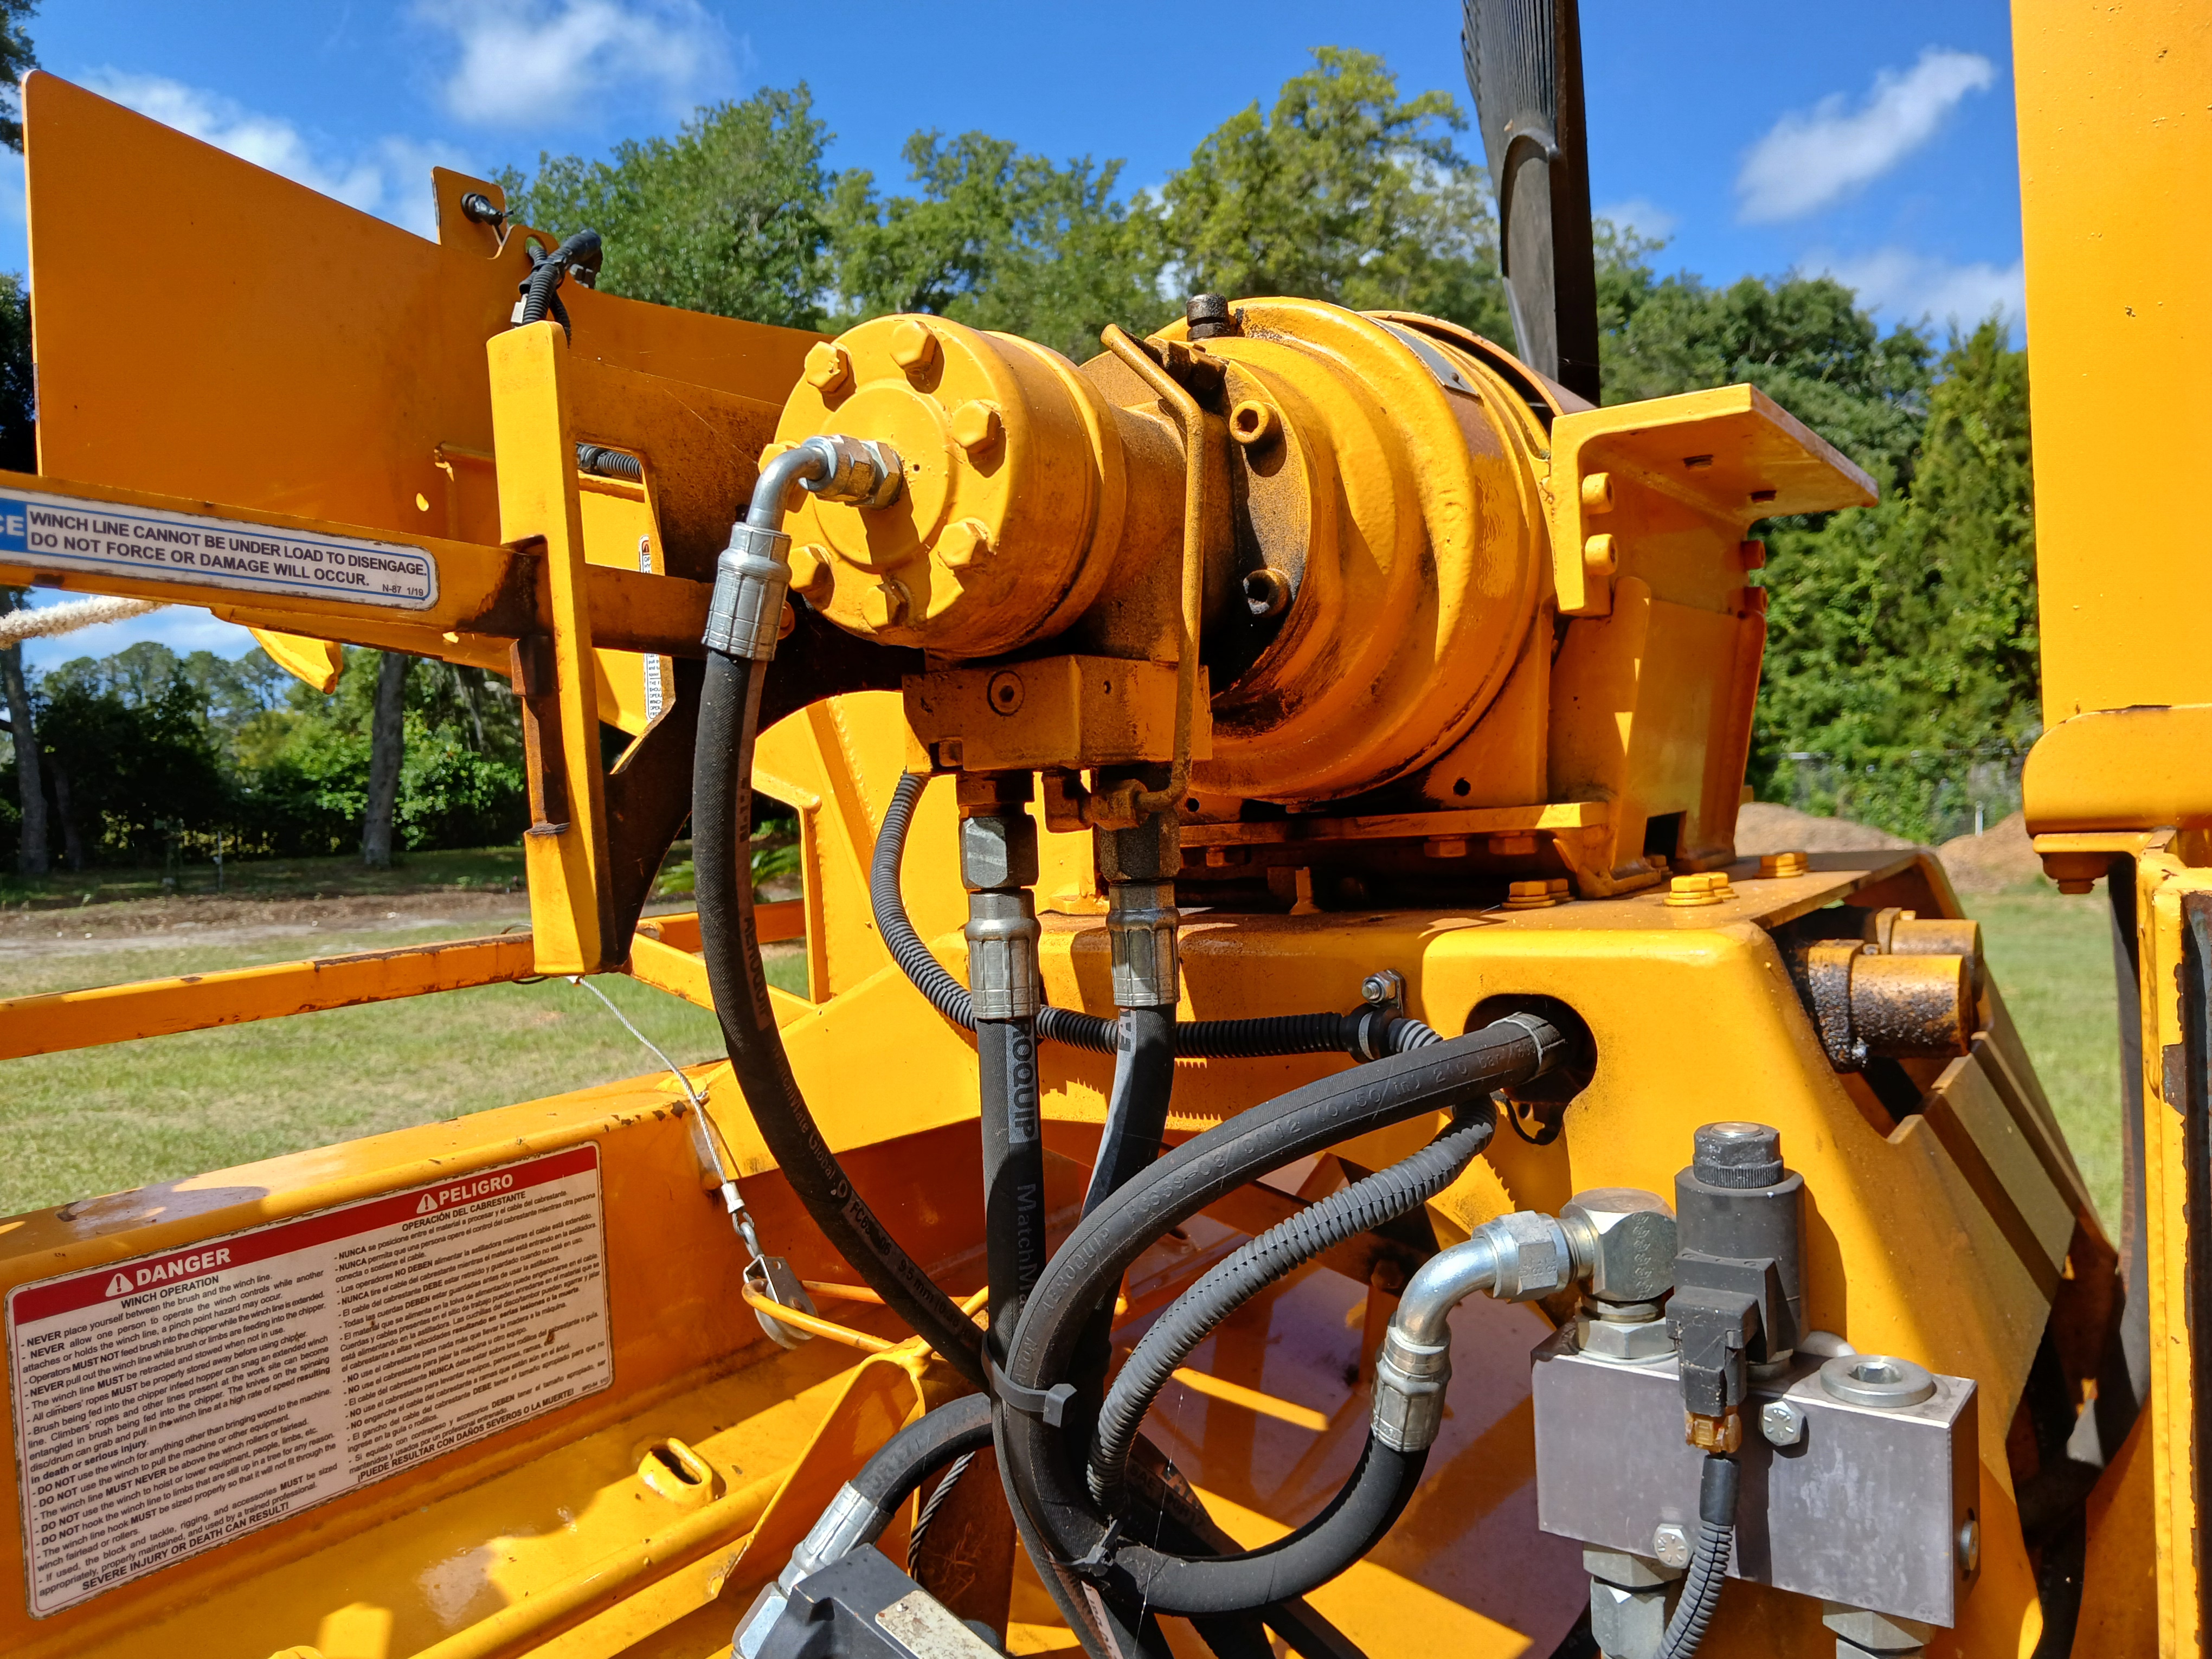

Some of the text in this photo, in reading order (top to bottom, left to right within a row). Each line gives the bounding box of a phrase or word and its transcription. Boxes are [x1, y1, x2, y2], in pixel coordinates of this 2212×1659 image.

[30, 511, 427, 576] WINCH LINE CANNOT BE UNDER LOAD TO DISENGAGE.
[31, 532, 369, 586] DO NOT FORCE OR DAMAGE WILL OCCUR.
[382, 584, 423, 596] N-87 1/19
[401, 1190, 526, 1232] OPERACIÓN DEL CABRESTANTE
[439, 1174, 513, 1206] PELIGRO
[120, 1274, 220, 1310] WINCH OPERATION
[136, 1248, 232, 1287] DANGER
[22, 1293, 284, 1374] attaches or holds the winch line, a pinch point hazard may occur.
[26, 1274, 273, 1348] NEVER place yourself between the brush and the winch line.
[29, 1269, 325, 1360] NEVER allow one person to operate the winch controls while another
[30, 1327, 286, 1410] The winch line MUST be retracted and stowed when not in use.
[32, 1411, 44, 1423] All
[85, 1392, 110, 1406] ropes
[111, 1381, 139, 1398] MUST
[139, 1379, 152, 1389] be
[152, 1368, 185, 1387] properly
[185, 1359, 211, 1375] stored
[211, 1354, 233, 1367] away
[233, 1346, 259, 1360] before
[258, 1339, 280, 1352] using
[30, 1439, 150, 1485] in death or serious injury.
[389, 1443, 436, 1468] RESULTAR
[436, 1435, 455, 1449] CON
[455, 1423, 485, 1442] DAÑOS
[485, 1408, 523, 1430] SEVEROS
[523, 1405, 530, 1414] O
[530, 1401, 542, 1412] LA
[542, 1387, 575, 1407] MUERTE!
[38, 1495, 55, 1508] DO
[56, 1486, 79, 1502] NOT
[80, 1482, 97, 1493] use
[98, 1476, 113, 1487] the
[113, 1465, 139, 1481] winch
[140, 1463, 150, 1472] to
[151, 1455, 166, 1470] pull
[167, 1452, 182, 1462] the
[182, 1439, 217, 1457] machine
[217, 1436, 227, 1445] or
[227, 1428, 249, 1441] other
[82, 1501, 290, 1591] SEVERE INJURY OR DEATH CAN RESULT!
